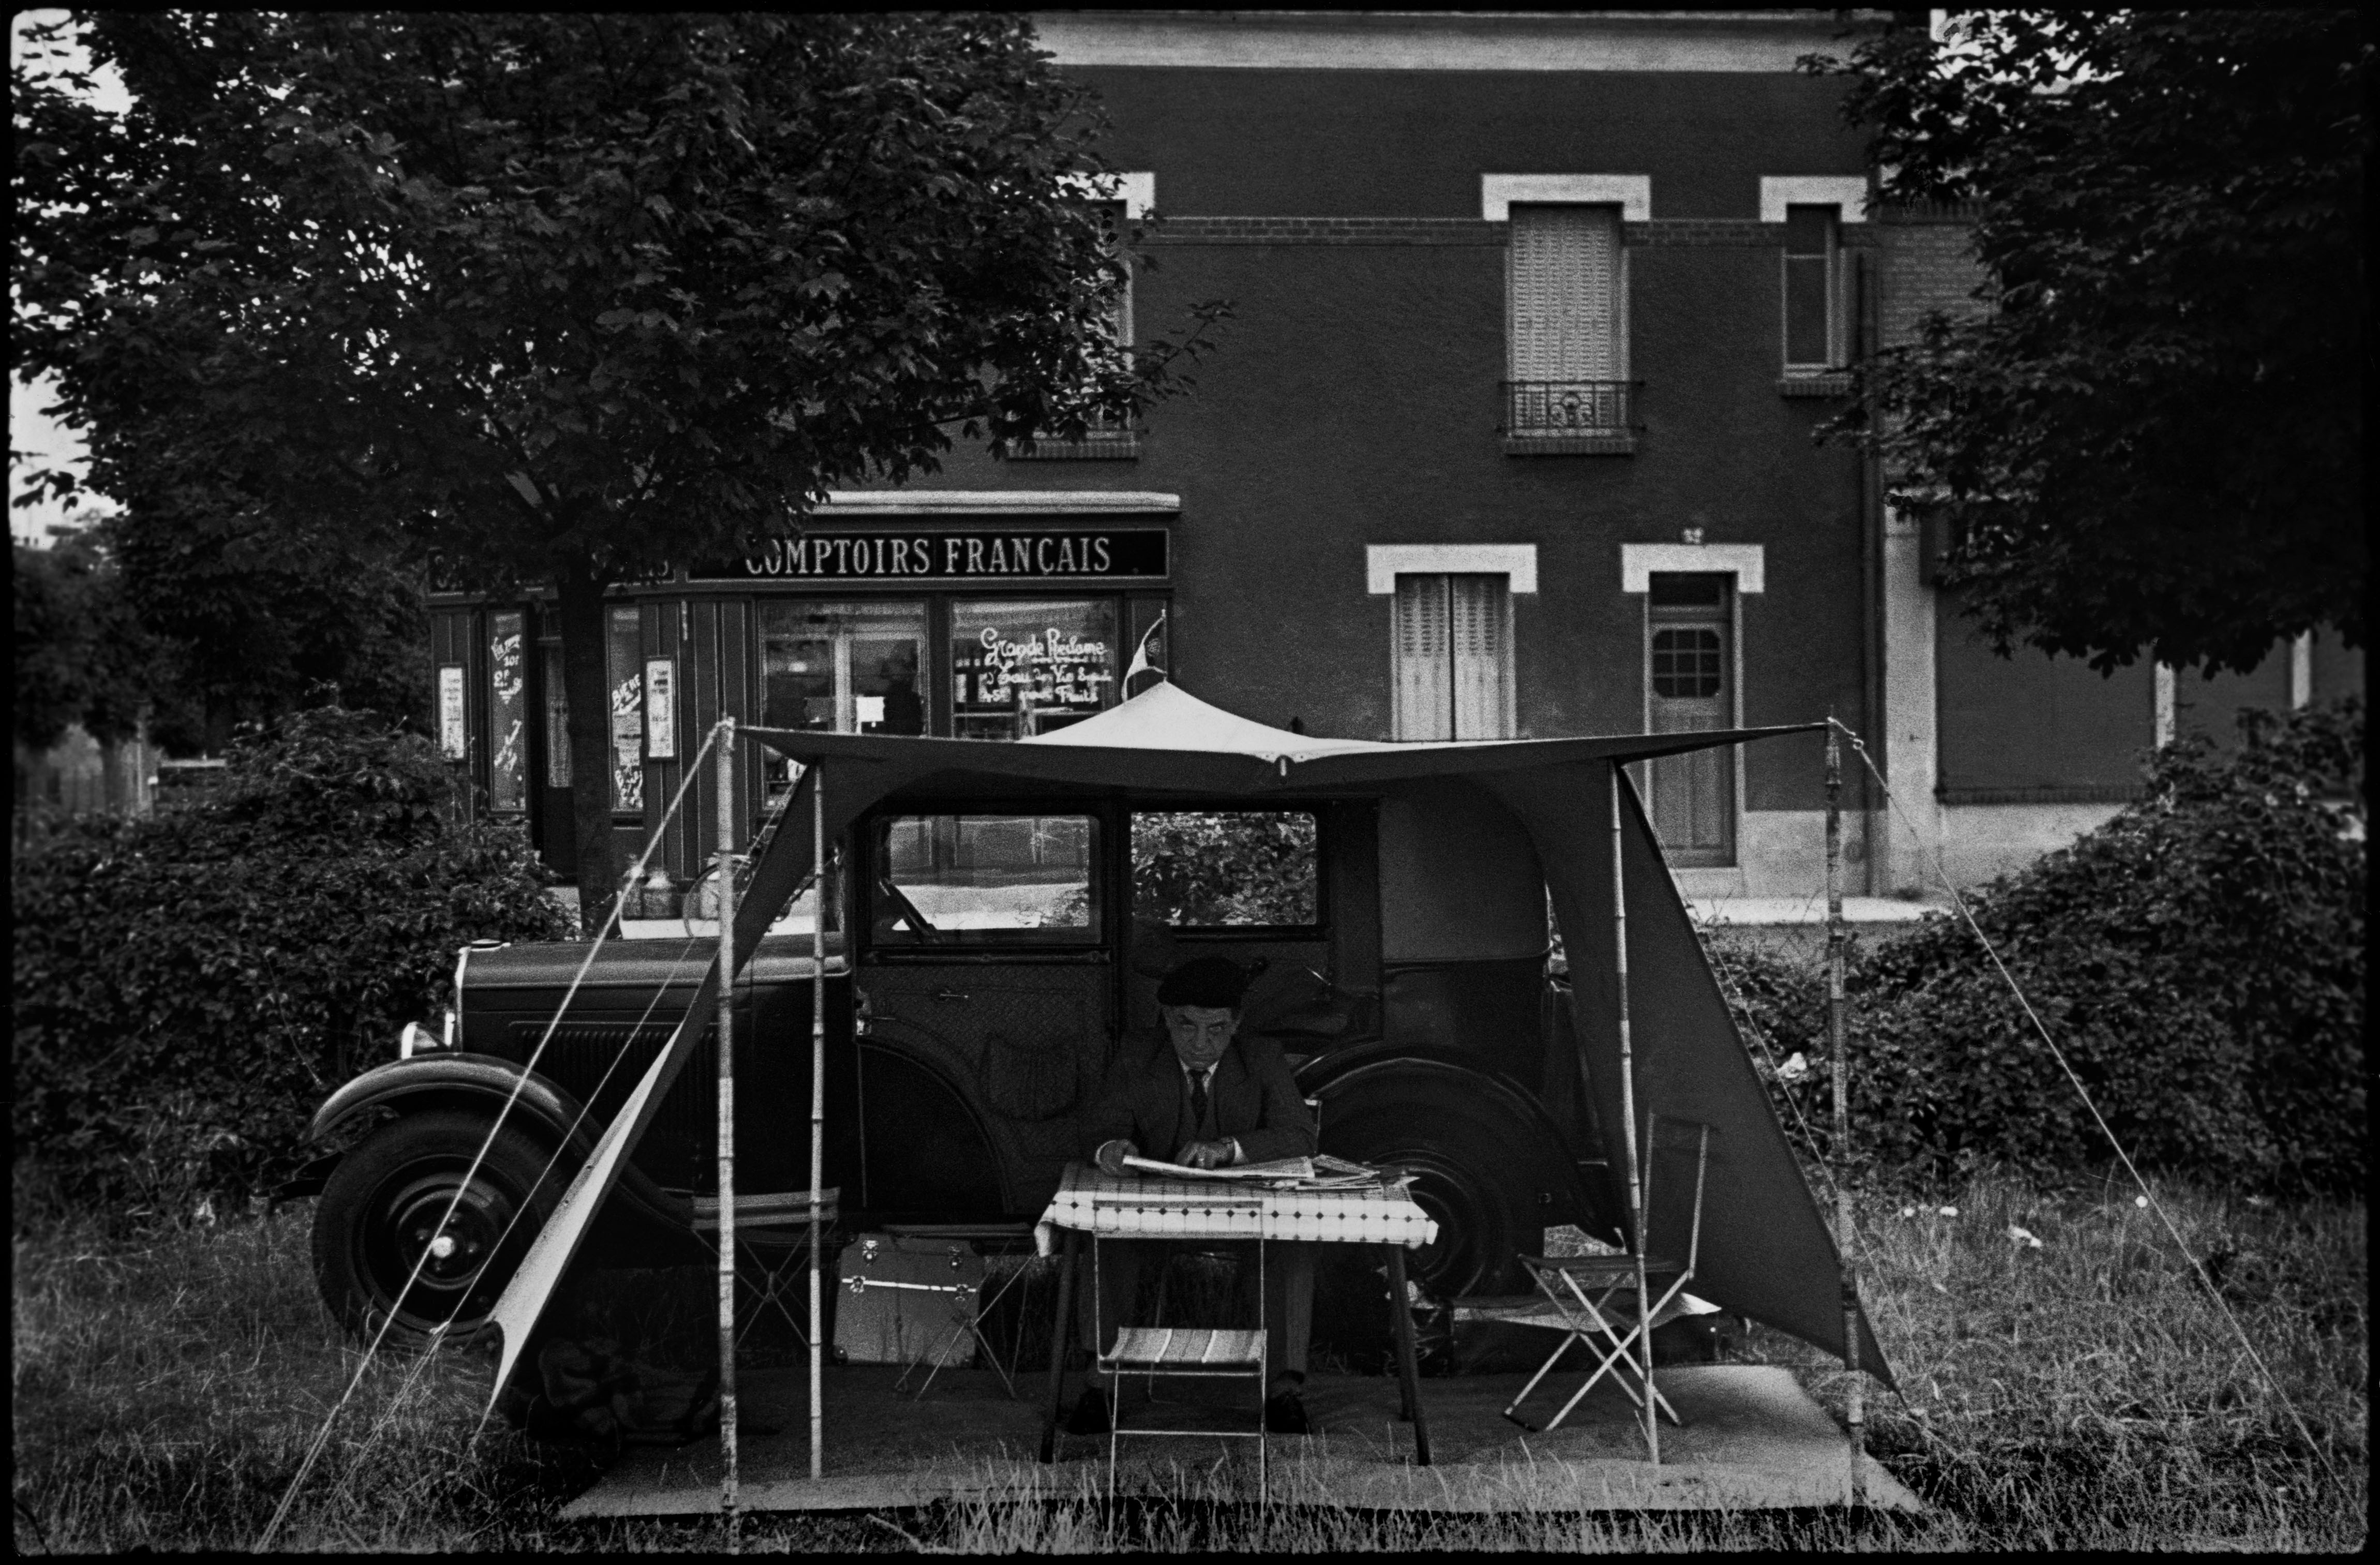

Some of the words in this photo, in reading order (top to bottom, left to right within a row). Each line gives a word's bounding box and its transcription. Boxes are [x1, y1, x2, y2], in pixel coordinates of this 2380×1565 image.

[944, 537, 1111, 575] FRANÇAIS
[980, 627, 1045, 666] Grande
[1049, 664, 1075, 683] Vie
